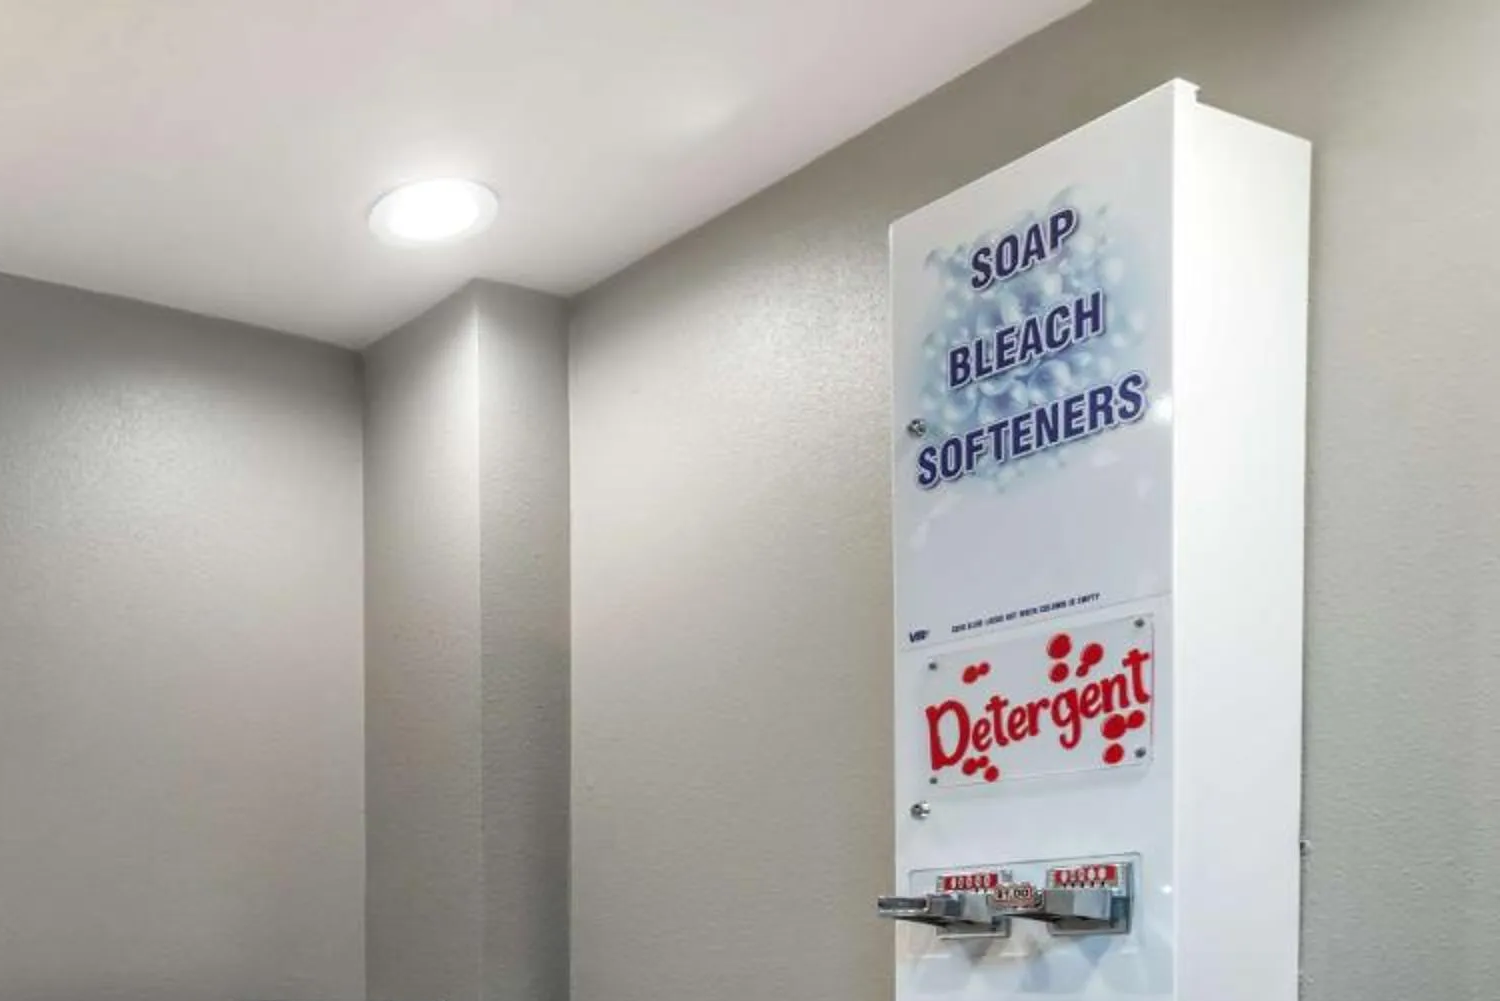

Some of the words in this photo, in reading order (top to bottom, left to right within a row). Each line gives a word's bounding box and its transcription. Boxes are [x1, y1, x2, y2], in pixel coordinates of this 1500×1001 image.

[970, 207, 1077, 290] SOAP
[947, 290, 1106, 389] BLEACH
[917, 372, 1147, 488] SOFTENERS
[925, 648, 1152, 771] Detergent
